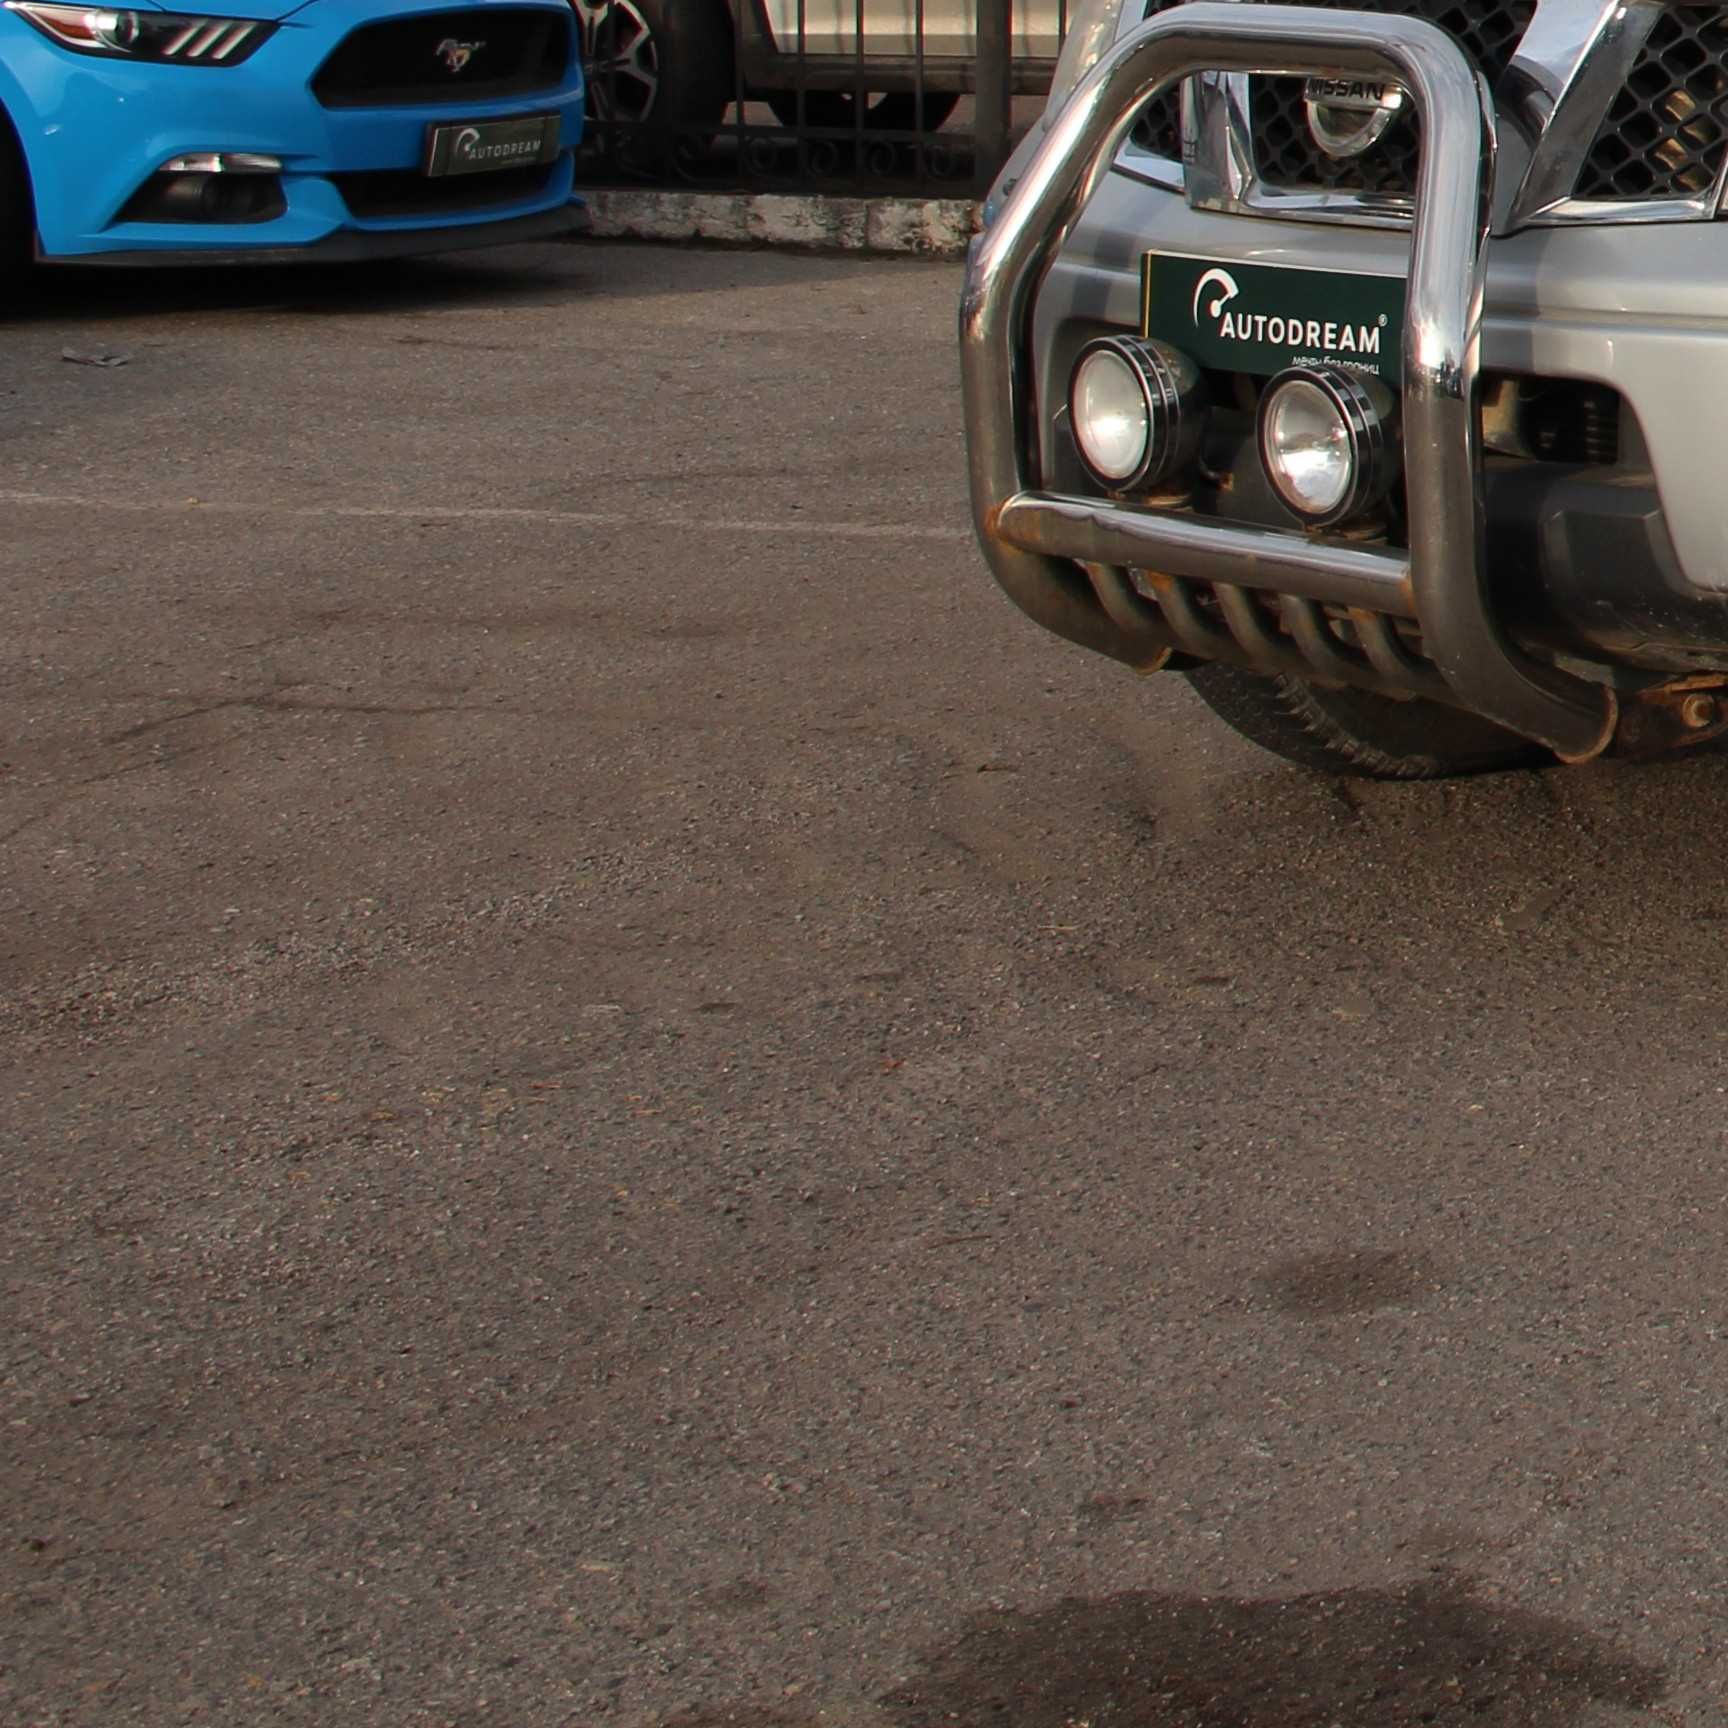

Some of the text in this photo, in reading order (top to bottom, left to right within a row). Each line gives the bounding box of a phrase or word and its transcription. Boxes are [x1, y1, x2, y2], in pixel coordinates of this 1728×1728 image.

[1308, 78, 1385, 101] NISSAN
[468, 140, 543, 160] AUTODREAM
[1220, 312, 1381, 354] AUTODREAM
